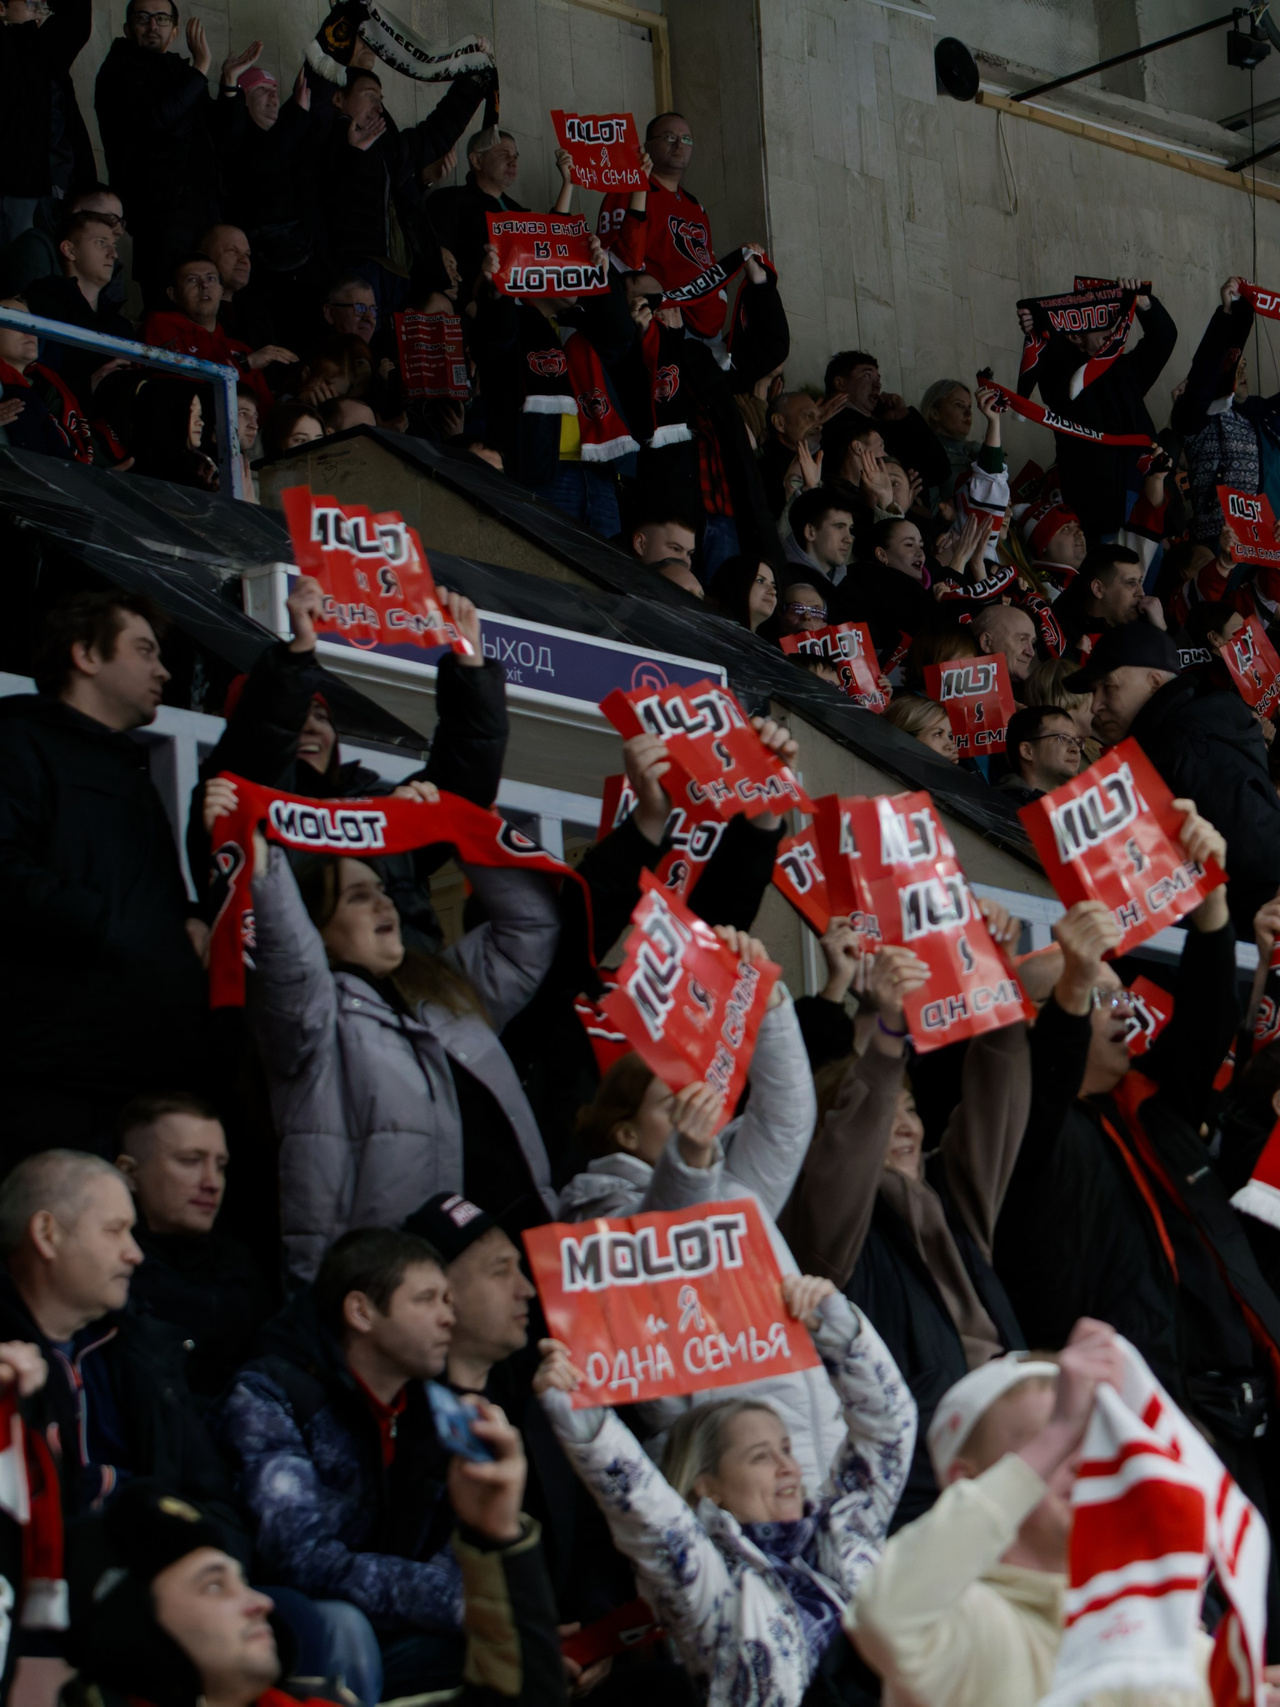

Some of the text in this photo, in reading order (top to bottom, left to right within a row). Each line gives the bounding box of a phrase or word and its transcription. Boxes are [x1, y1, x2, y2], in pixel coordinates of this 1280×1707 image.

[504, 265, 610, 293] MOLOT
[663, 261, 728, 302] MOLO
[1048, 302, 1121, 332] МОЛОТ
[309, 505, 421, 567] MOLO
[482, 631, 556, 678] ЫХОД
[505, 668, 524, 684] xit
[266, 799, 389, 851] MOLOT
[560, 1211, 749, 1293] MOLOT
[677, 1283, 707, 1334] Я
[585, 1321, 792, 1399] ОДНА СЕМЬЯ
